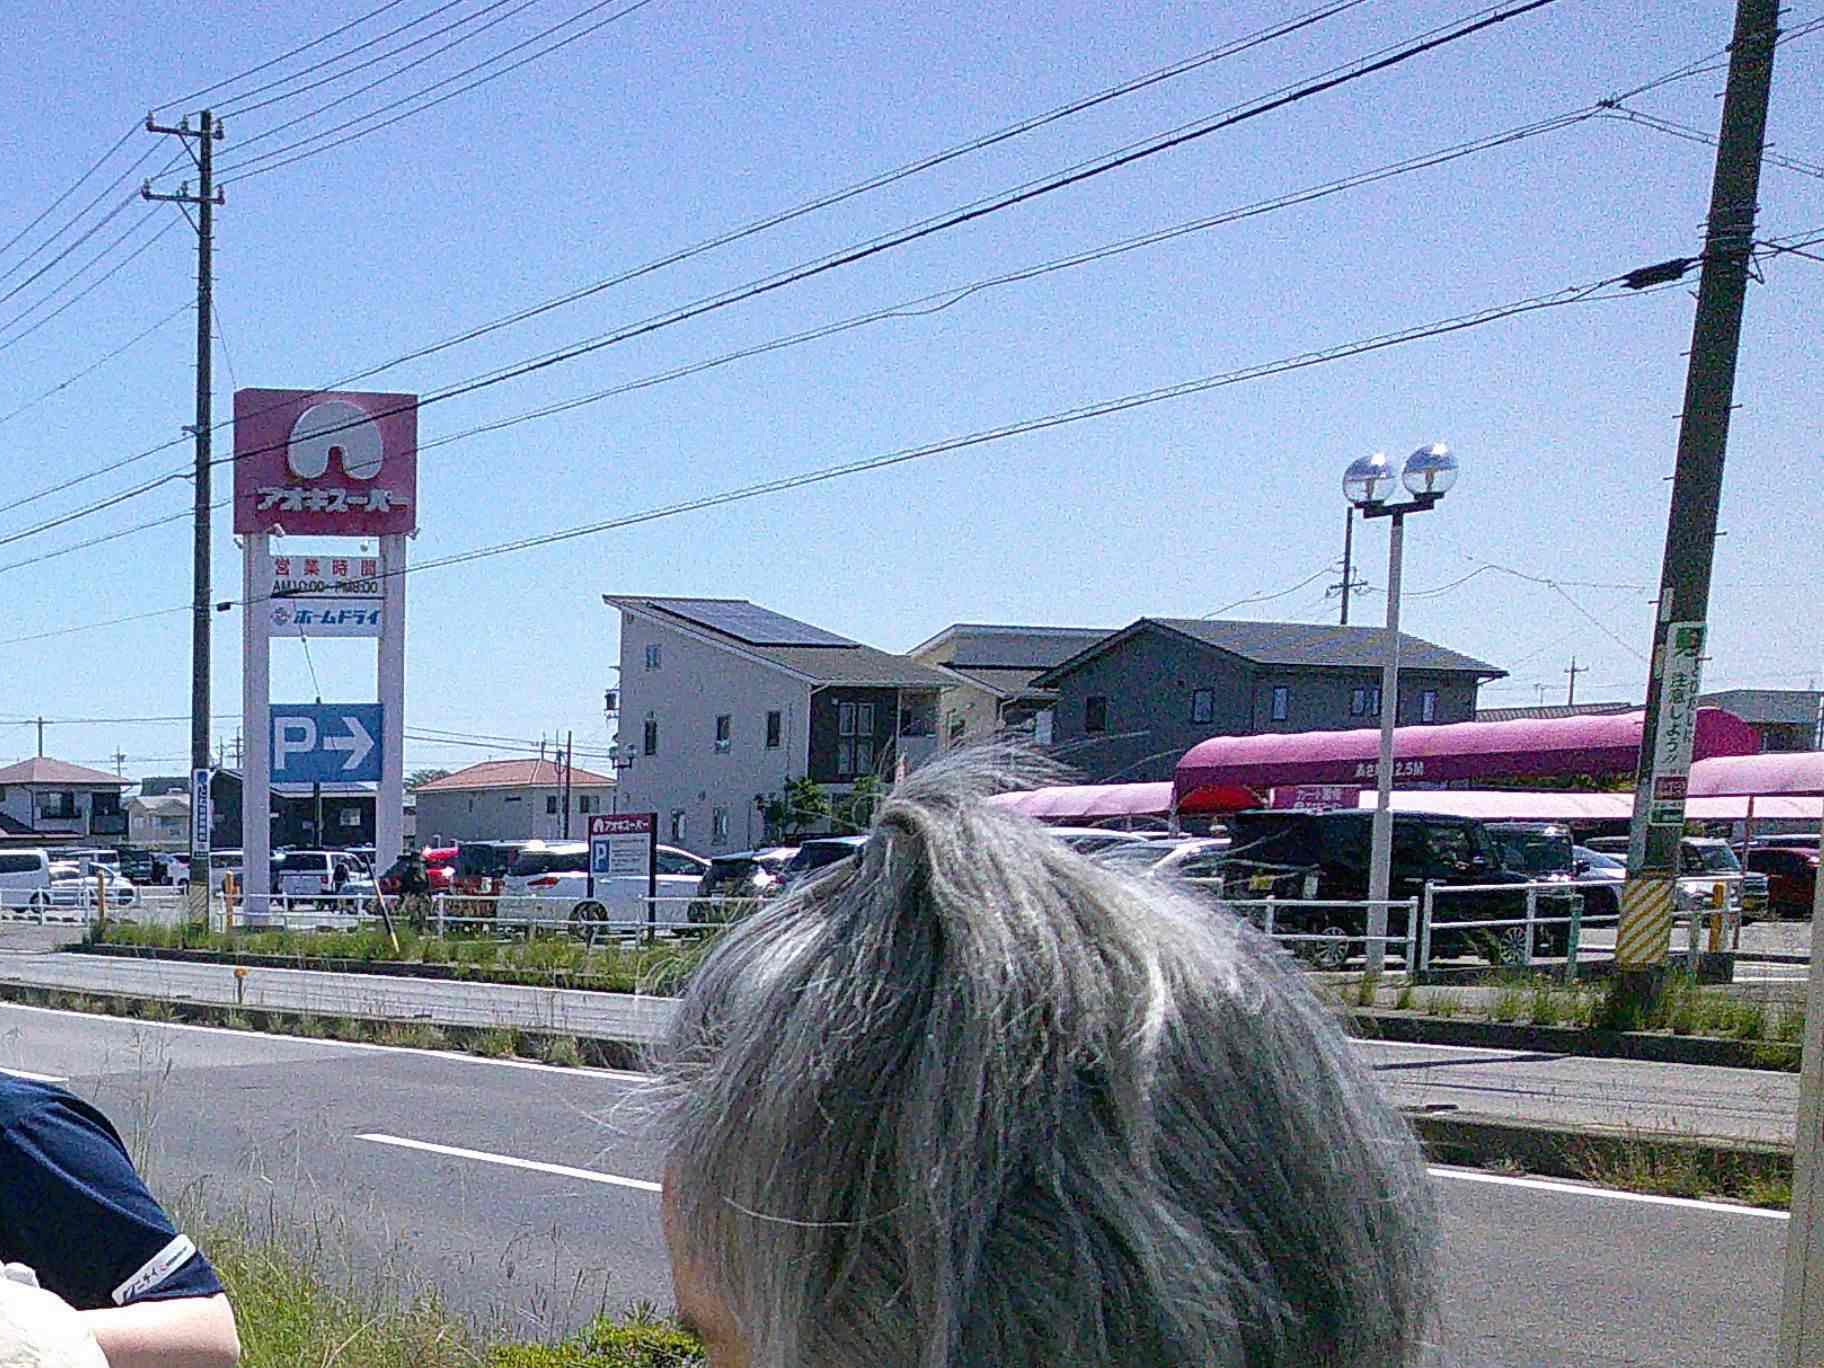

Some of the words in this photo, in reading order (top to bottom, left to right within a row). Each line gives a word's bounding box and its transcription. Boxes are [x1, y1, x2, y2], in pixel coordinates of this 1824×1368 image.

[255, 486, 409, 512] アオキスーパー
[293, 610, 380, 624] ホームドライ
[274, 717, 317, 770] P
[595, 843, 607, 869] P
